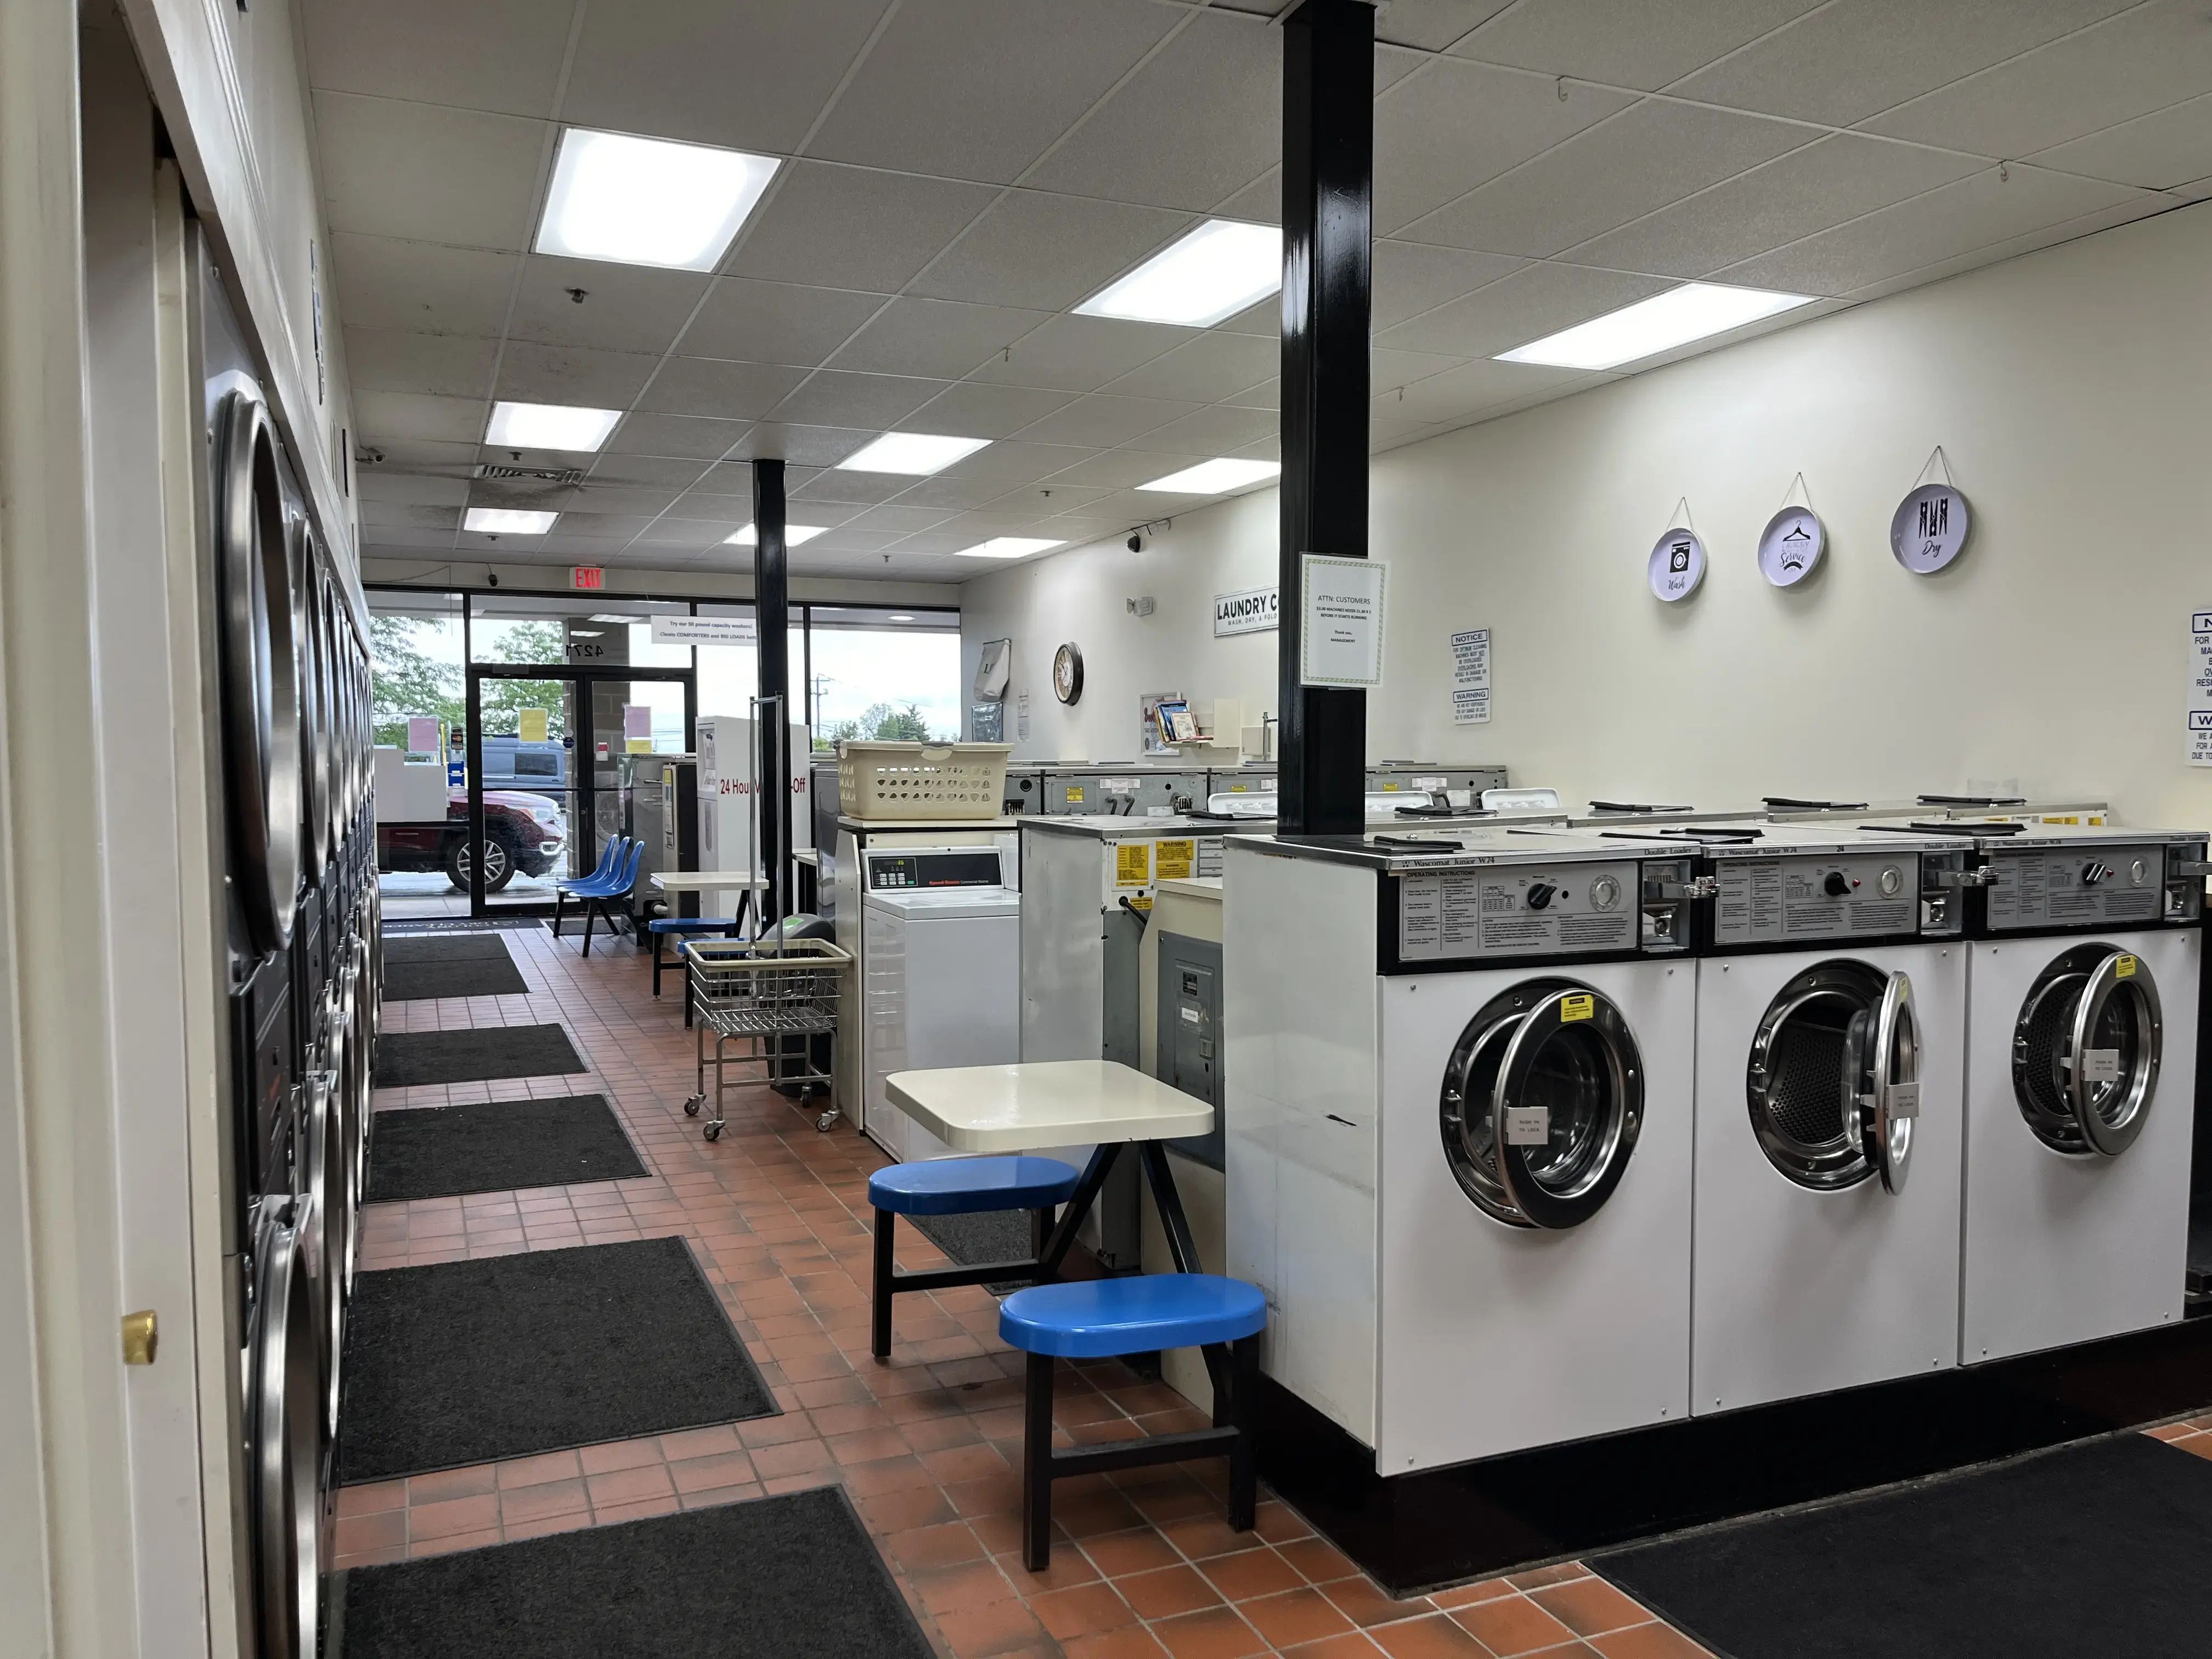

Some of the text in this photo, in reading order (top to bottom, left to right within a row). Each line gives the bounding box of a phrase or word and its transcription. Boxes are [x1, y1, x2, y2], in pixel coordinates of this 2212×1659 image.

[1922, 540, 1943, 558] Dry
[575, 568, 601, 588] EXIT
[1668, 575, 1685, 590] Wash
[1217, 595, 1266, 620] LAUNDRY
[1455, 633, 1483, 642] NOTICE
[1456, 691, 1486, 699] WARNING
[721, 779, 730, 794] 24
